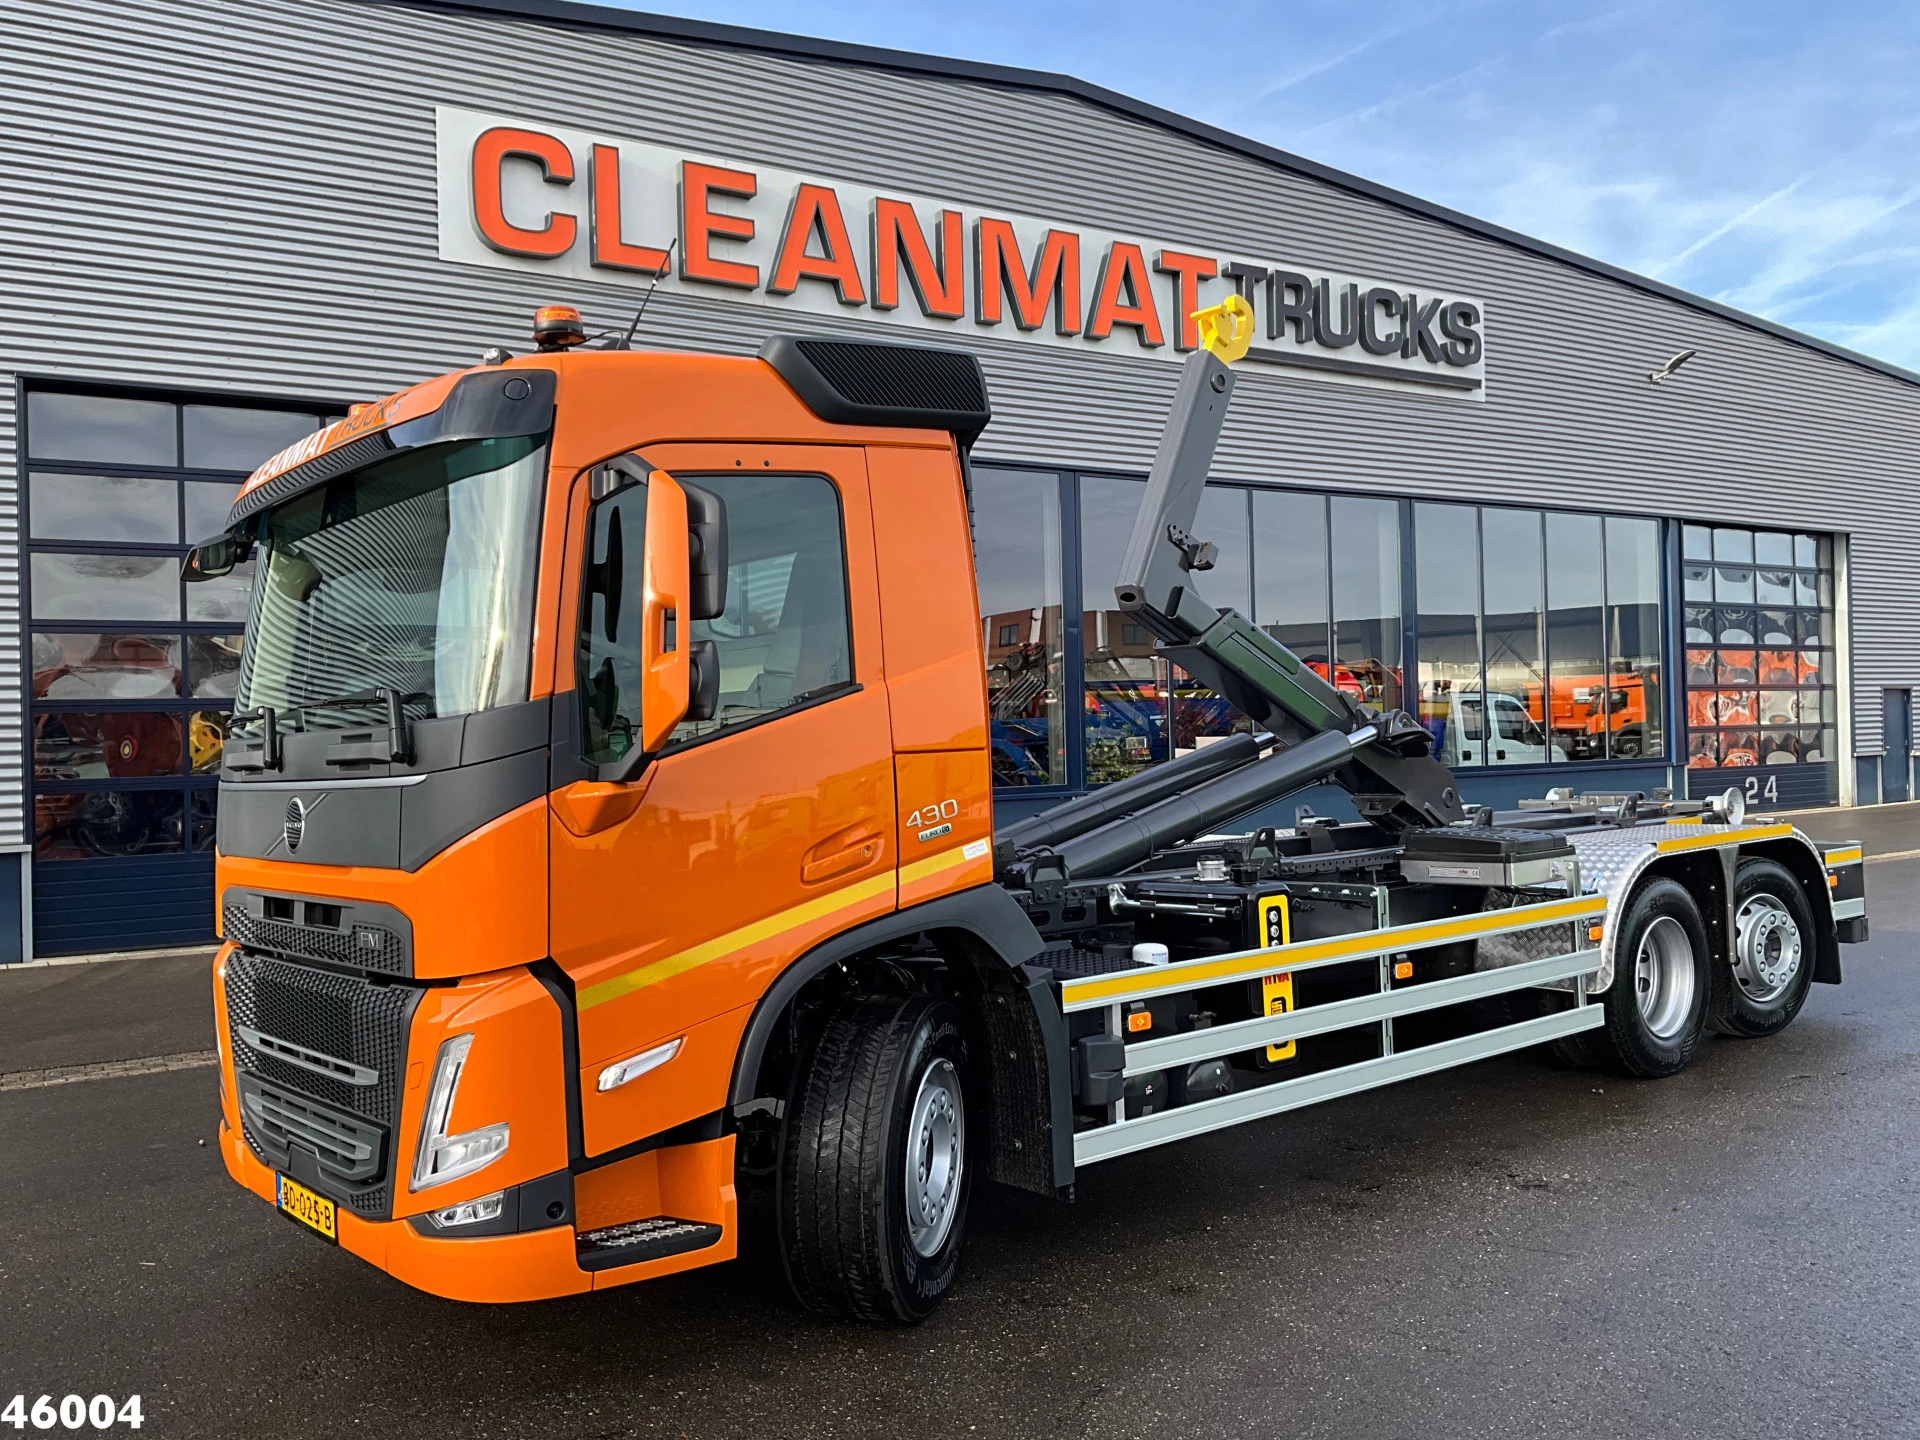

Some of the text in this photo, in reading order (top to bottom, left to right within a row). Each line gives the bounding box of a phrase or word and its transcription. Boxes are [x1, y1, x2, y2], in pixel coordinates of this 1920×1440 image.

[472, 126, 1483, 368] CLEANMAT TRUCKS
[333, 393, 408, 440] TRUCKS
[1744, 774, 1779, 806] 24
[905, 798, 959, 828] 430
[360, 932, 379, 949] FM
